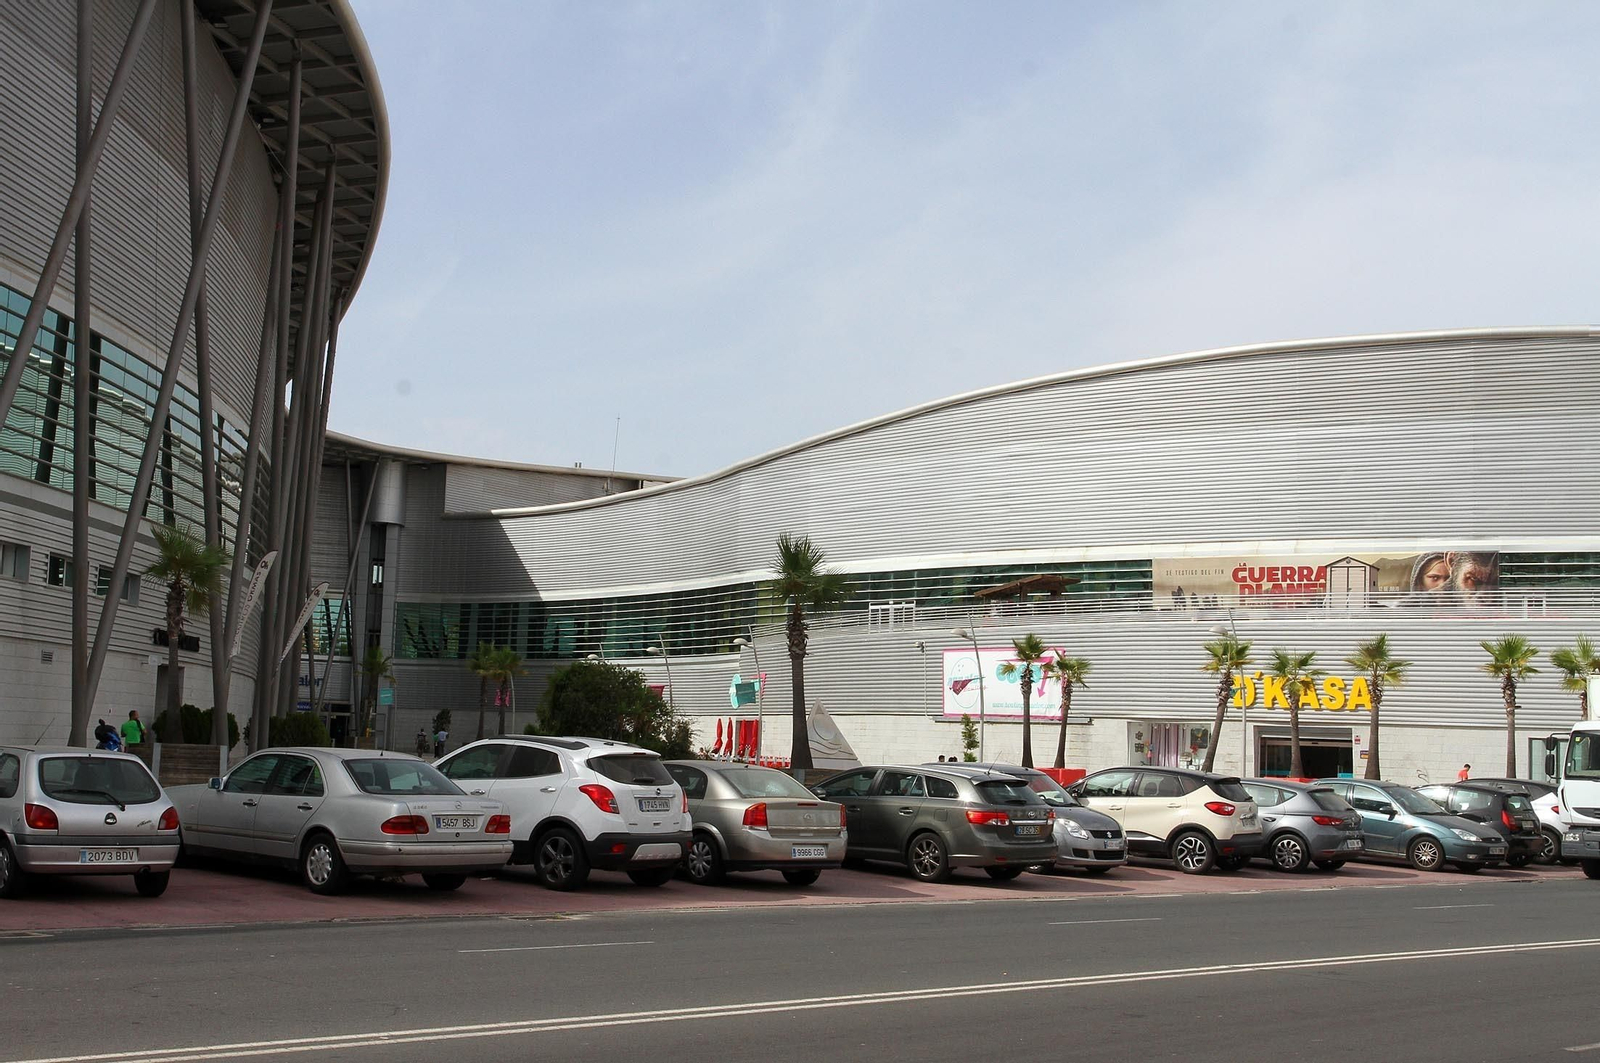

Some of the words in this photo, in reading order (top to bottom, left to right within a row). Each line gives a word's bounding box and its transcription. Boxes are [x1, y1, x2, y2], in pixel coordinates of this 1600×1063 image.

[1231, 566, 1327, 583] GUERRA
[442, 818, 458, 827] 5457
[462, 818, 475, 827] BSJ
[88, 852, 113, 861] 2073
[116, 851, 134, 861] BDV
